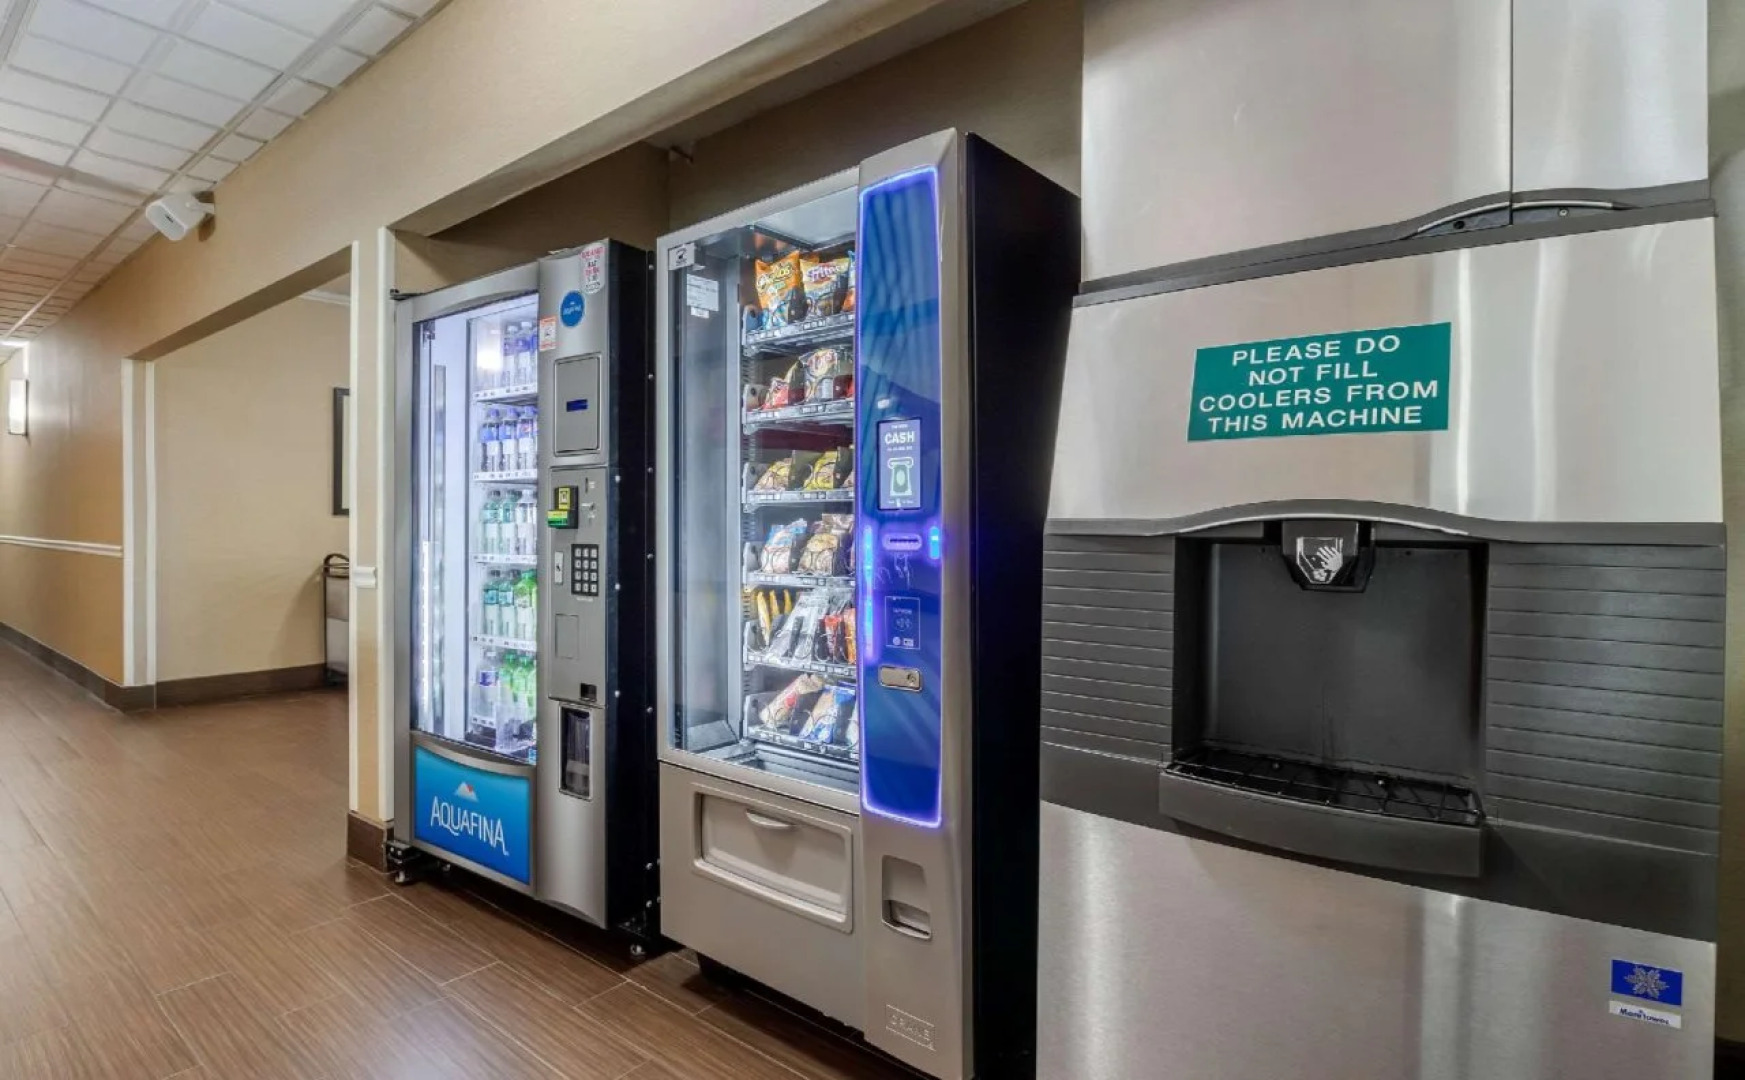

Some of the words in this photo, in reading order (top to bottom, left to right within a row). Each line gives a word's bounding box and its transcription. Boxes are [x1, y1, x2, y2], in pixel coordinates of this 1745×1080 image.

[1232, 340, 1341, 366] PLEASE
[1355, 335, 1400, 355] DO
[1249, 366, 1304, 386] NOT
[1316, 360, 1378, 381] FILL
[1200, 386, 1332, 412] COOLERS
[1347, 380, 1438, 403] FROM
[1208, 414, 1268, 433] THIS
[1282, 405, 1422, 429] MACHINE
[885, 430, 915, 444] CASH
[430, 795, 510, 857] AQUAFINA
